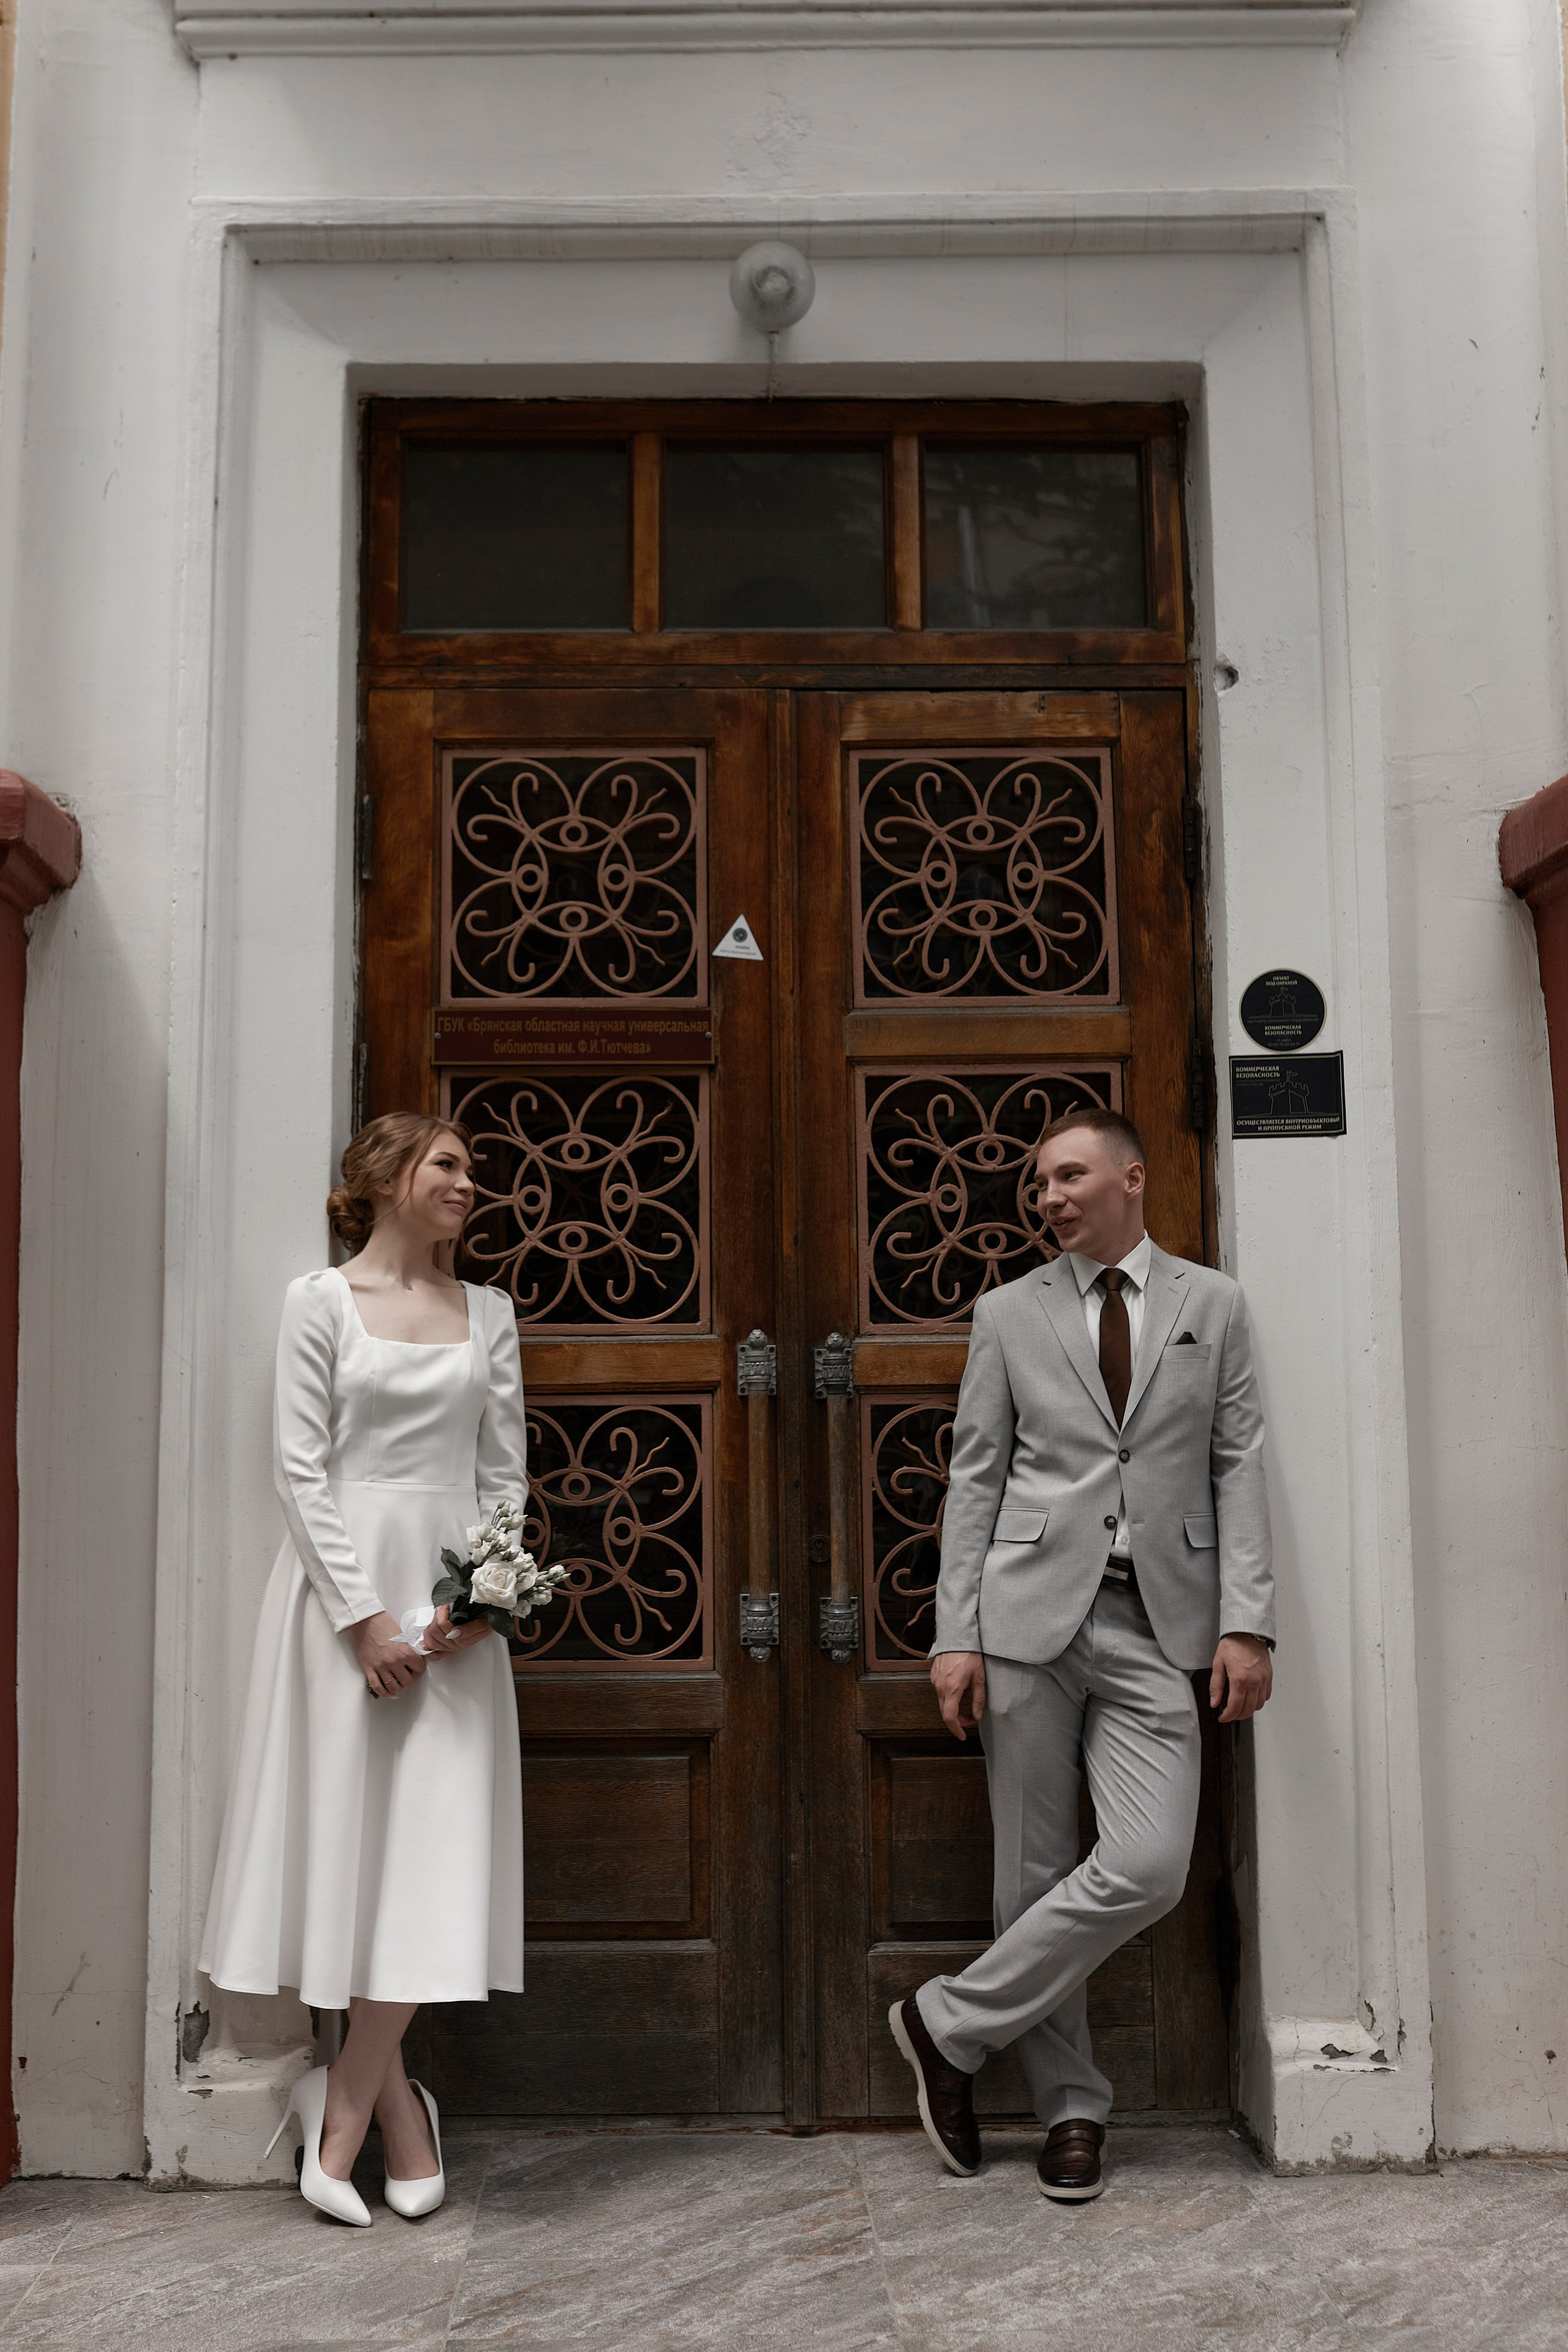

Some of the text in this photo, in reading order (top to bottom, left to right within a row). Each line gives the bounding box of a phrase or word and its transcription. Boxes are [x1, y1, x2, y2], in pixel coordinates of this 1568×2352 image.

[437, 1017, 709, 1036] ГБУК «Брянская областная научная универсальная
[494, 1039, 556, 1054] библиотека
[558, 1042, 575, 1054] им.
[1286, 1116, 1340, 1125] ВНУТРИОБЪЕКТОВЫЙ
